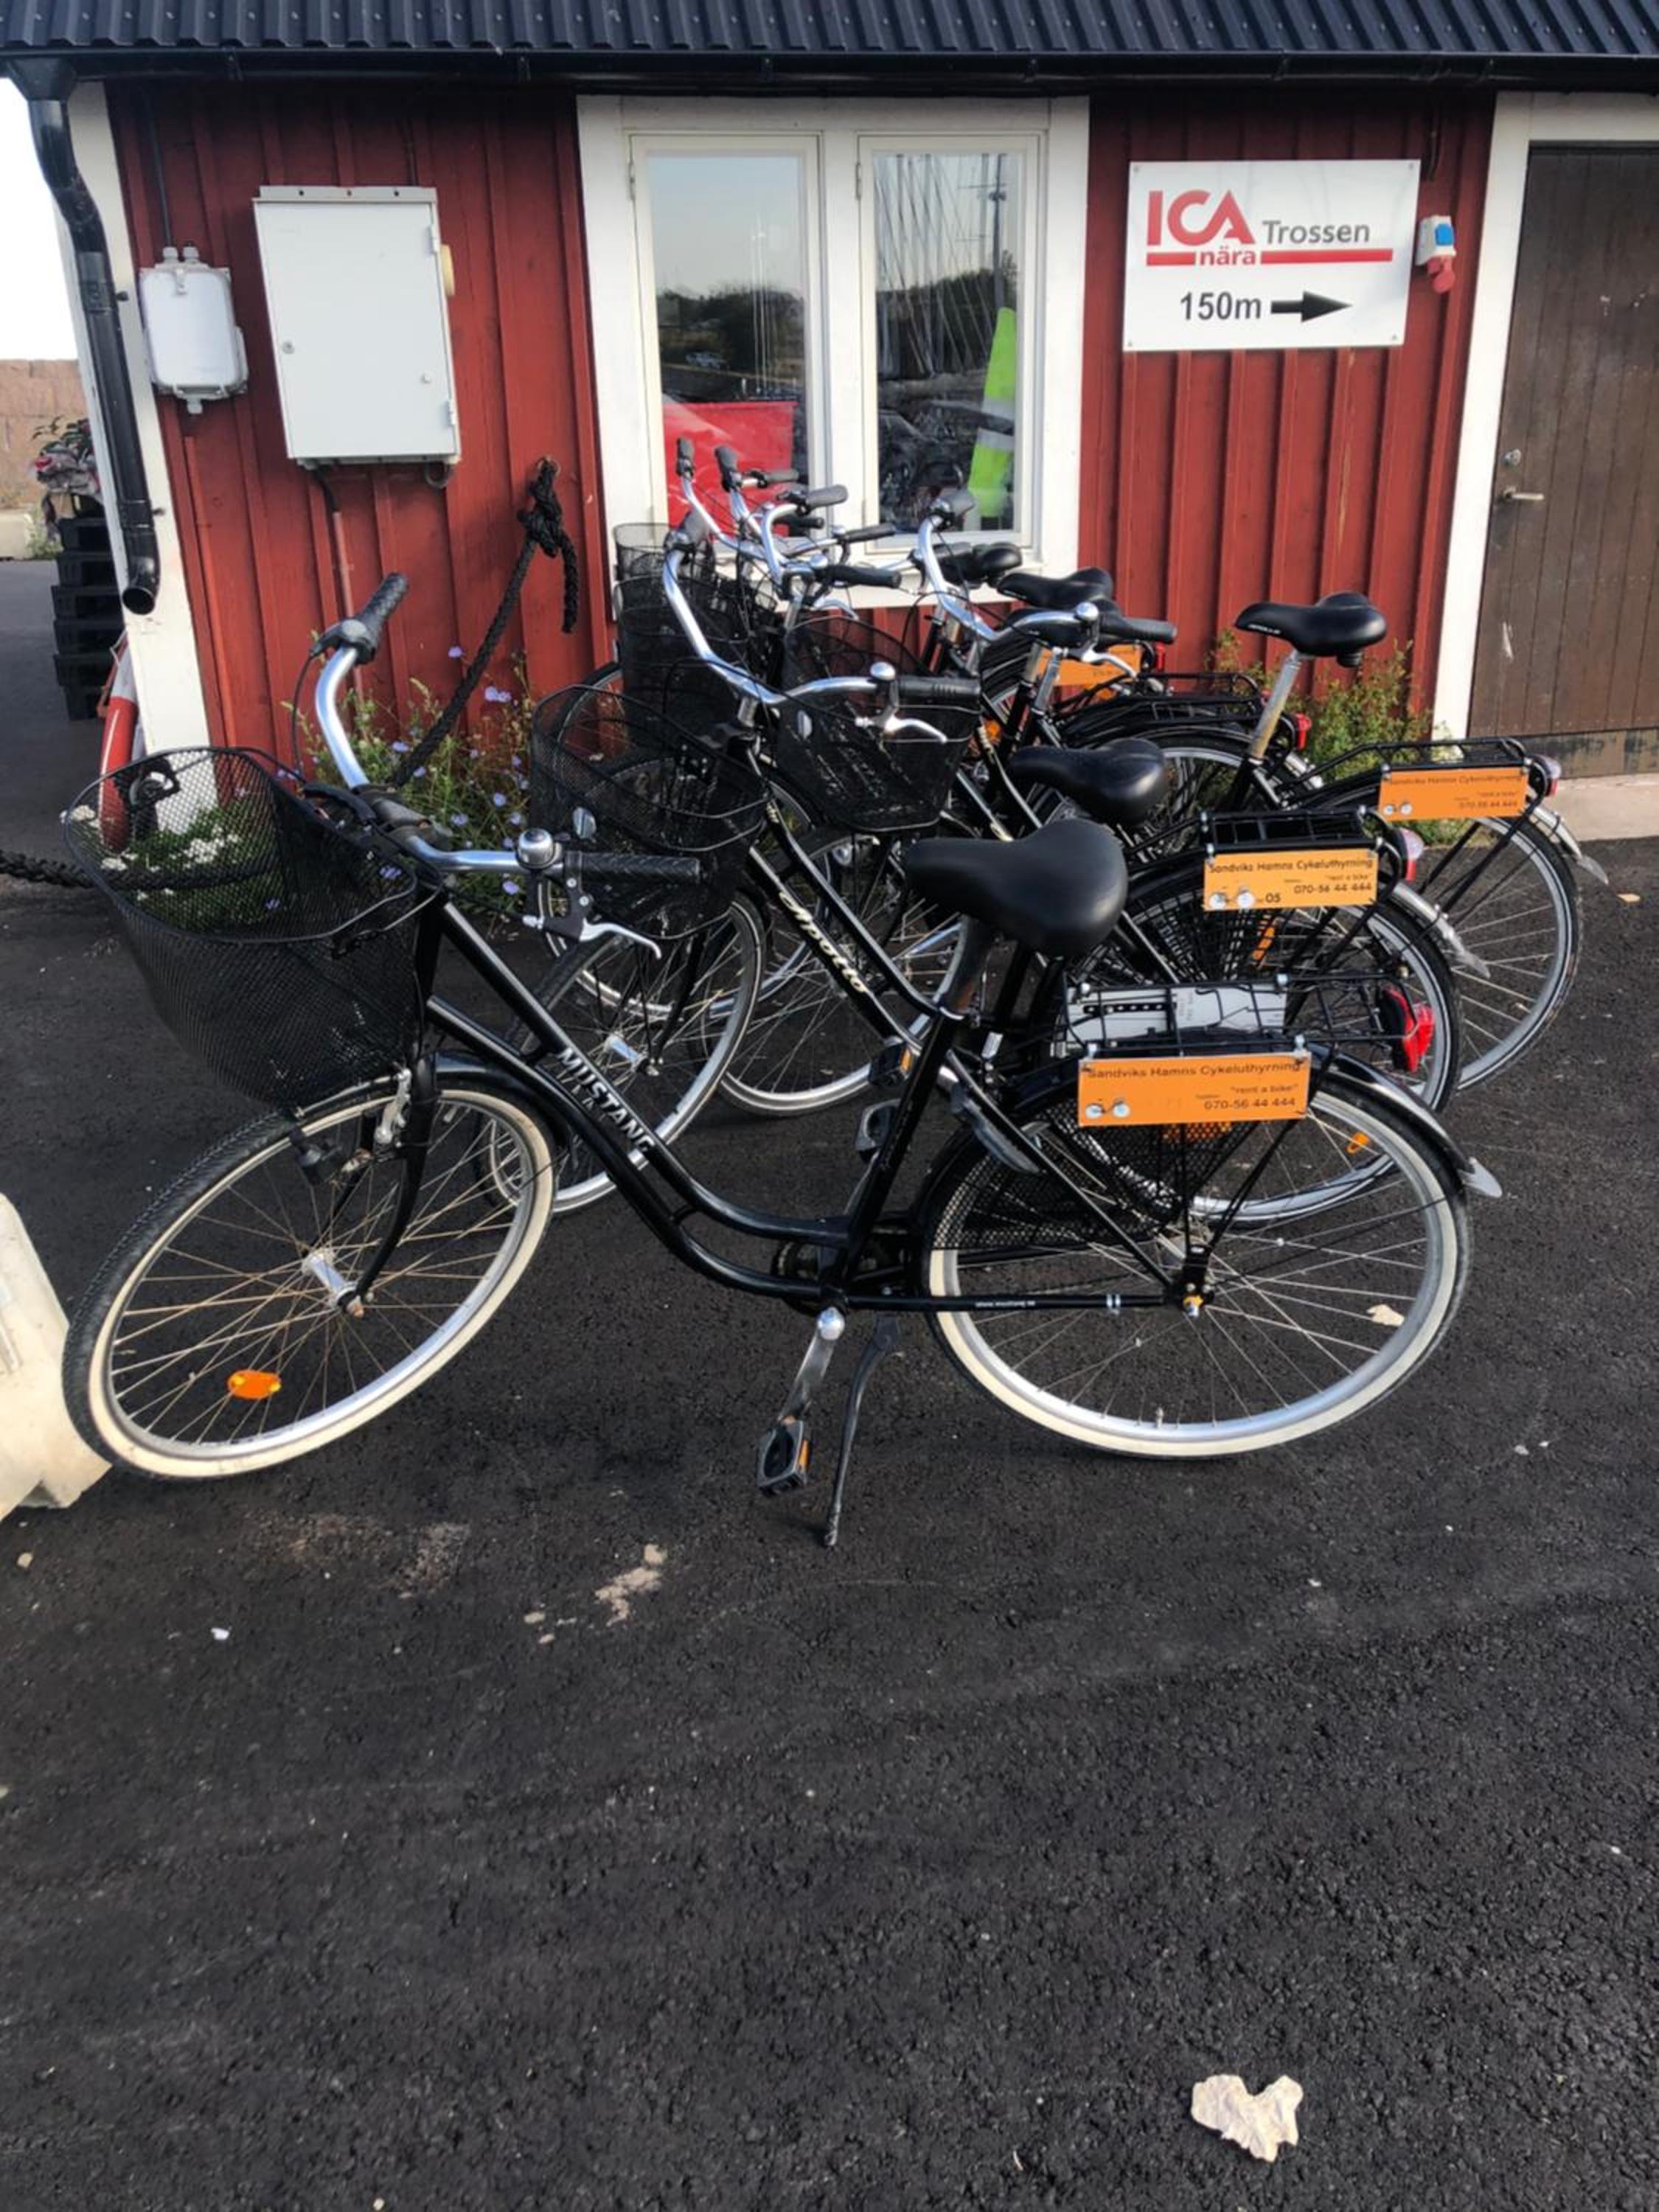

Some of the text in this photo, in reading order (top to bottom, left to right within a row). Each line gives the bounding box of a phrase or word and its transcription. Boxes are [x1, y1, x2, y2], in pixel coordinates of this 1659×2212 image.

[1146, 189, 1370, 246] ICA Trossen
[1200, 246, 1256, 267] nära
[1180, 292, 1262, 320] 150m
[1265, 893, 1281, 903] 05
[1088, 1067, 1146, 1078] Sandviks
[1150, 1065, 1196, 1077] Hamns
[557, 1047, 655, 1152] MUSTANG
[1204, 1097, 1295, 1109] 070-56 44 444
